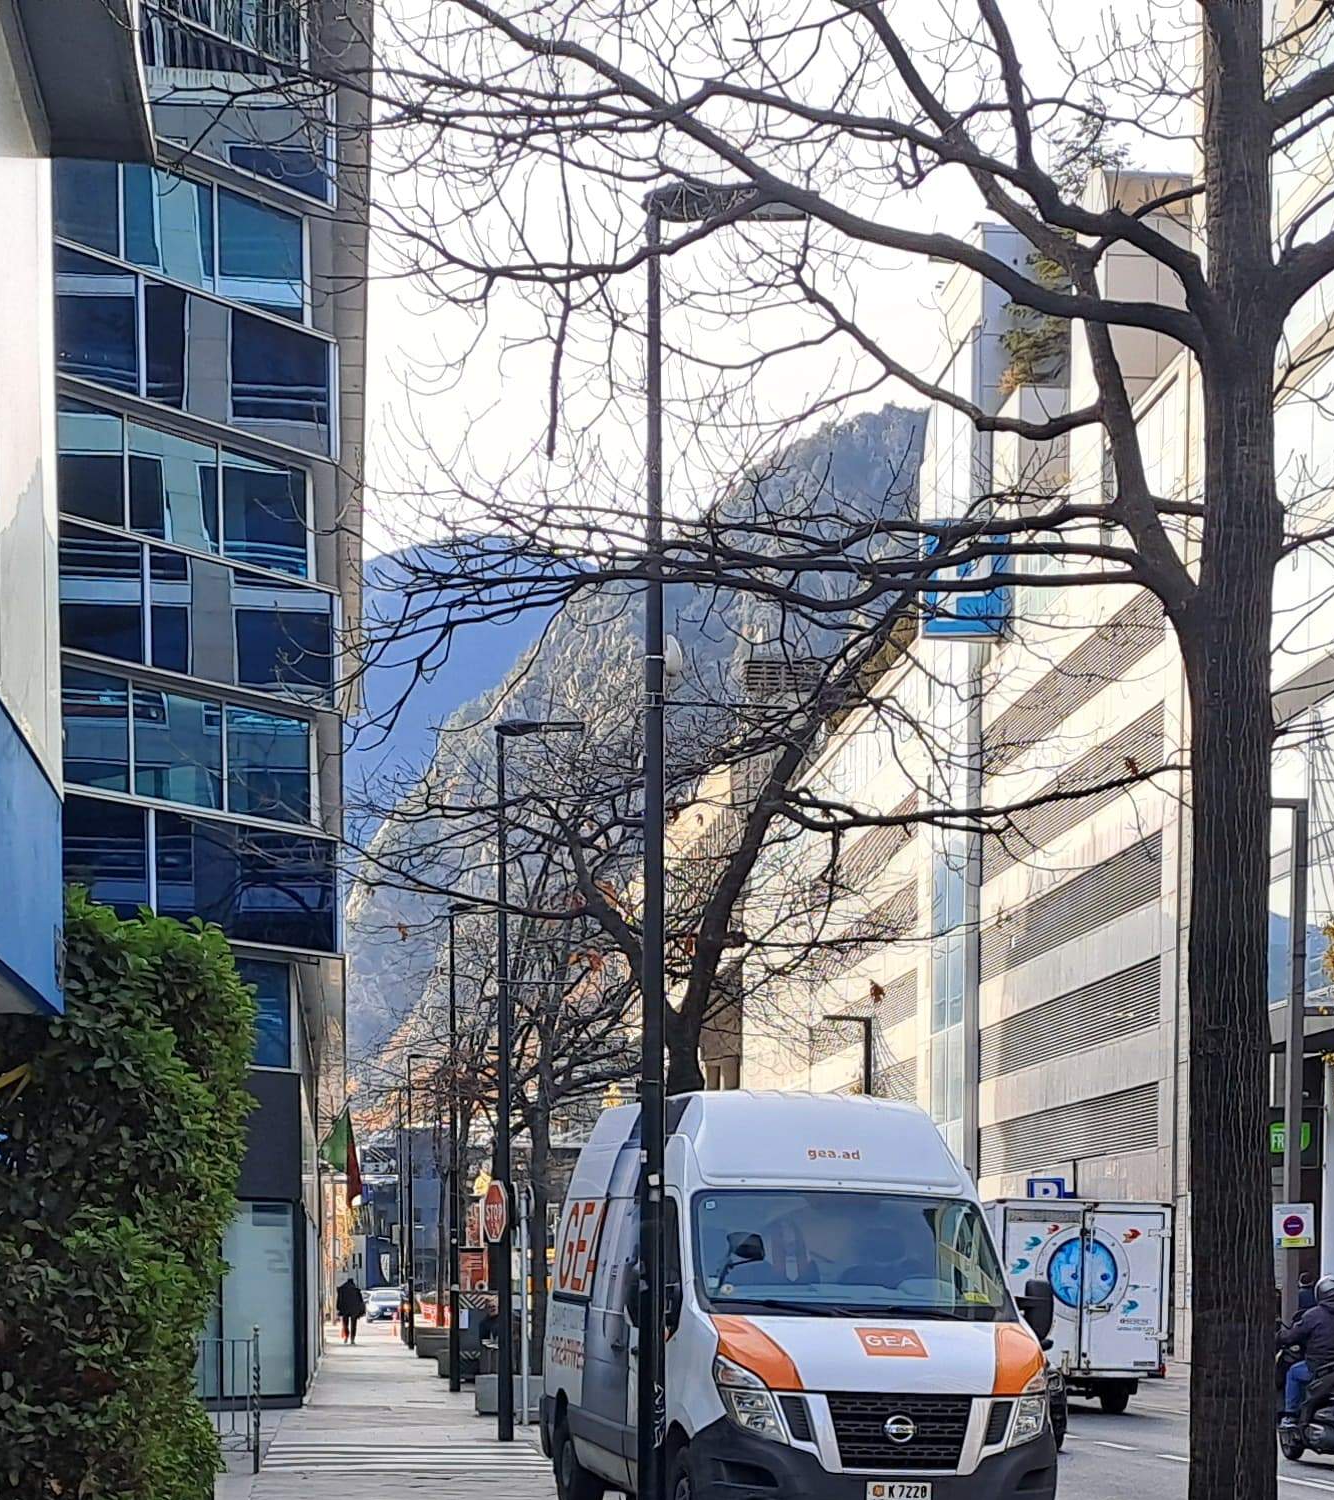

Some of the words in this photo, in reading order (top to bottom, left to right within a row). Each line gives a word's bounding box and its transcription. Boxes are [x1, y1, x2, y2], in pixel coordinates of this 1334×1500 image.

[807, 1149, 861, 1161] gea.ad
[486, 1204, 503, 1221] STOP
[865, 1334, 918, 1348] GEA
